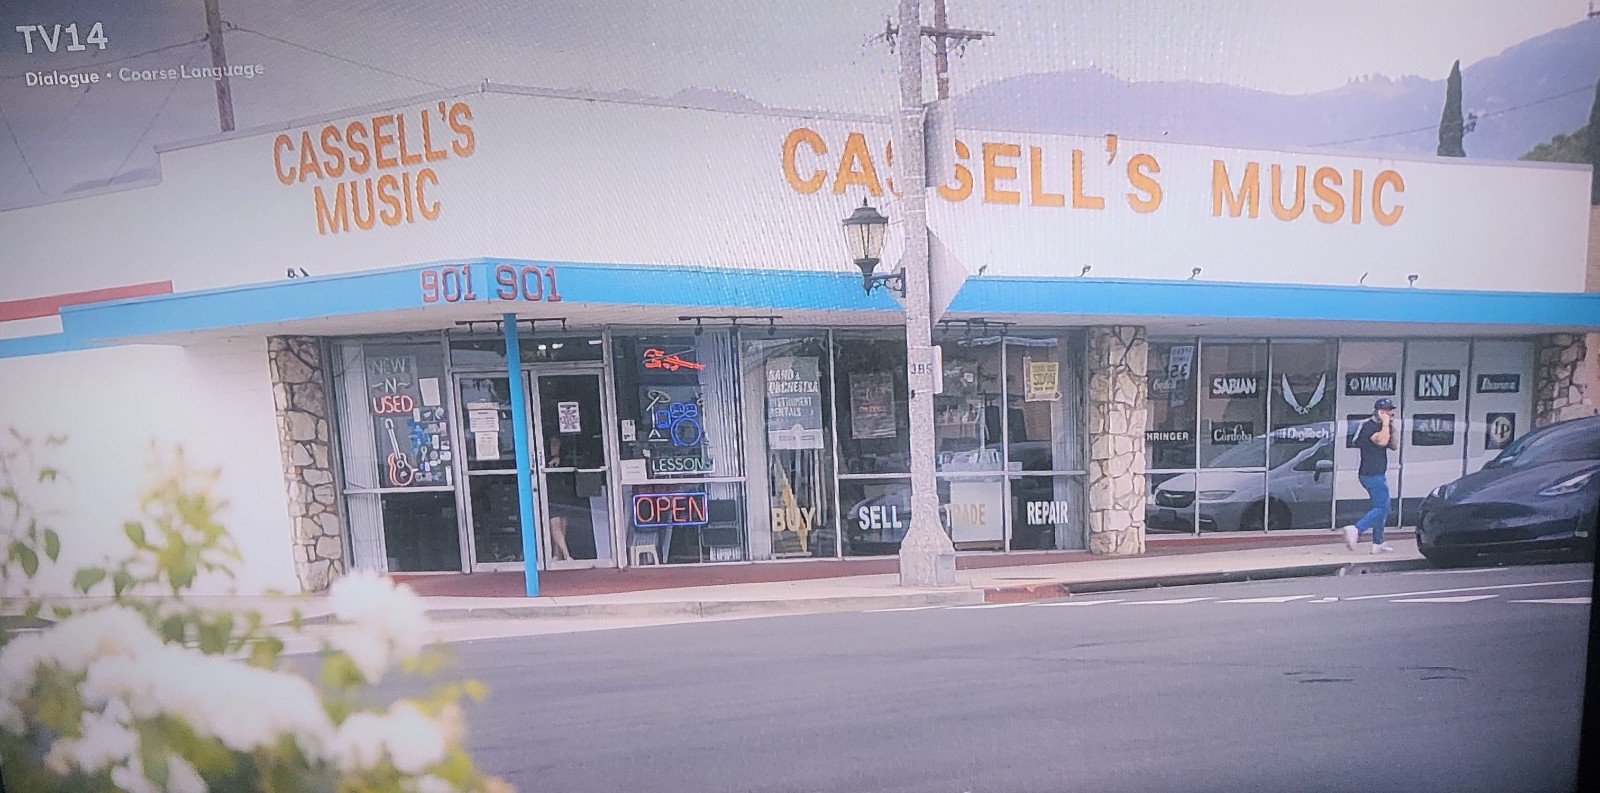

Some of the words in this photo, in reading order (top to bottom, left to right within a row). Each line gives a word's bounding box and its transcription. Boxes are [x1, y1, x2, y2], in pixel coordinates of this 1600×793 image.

[16, 22, 108, 54] TV14
[25, 70, 99, 87] Dialogue
[118, 67, 177, 82] Coarse
[180, 62, 265, 82] Language
[273, 101, 476, 185] CASSELL'S
[782, 128, 1163, 213] CASELL'S
[1211, 160, 1406, 227] MUSIC
[313, 169, 442, 235] MUSIC
[421, 264, 476, 303] 901
[496, 264, 562, 303] 901
[372, 357, 405, 375] NEW
[1212, 378, 1256, 394] SABIAN
[1360, 376, 1393, 392] YAMAHA
[1418, 374, 1457, 397] ESP
[373, 395, 414, 414] USED
[1494, 421, 1510, 439] LP
[636, 496, 706, 523] OPEN
[772, 506, 816, 532] BUY
[858, 505, 903, 530] SELL
[1027, 501, 1069, 525] REPAIR
